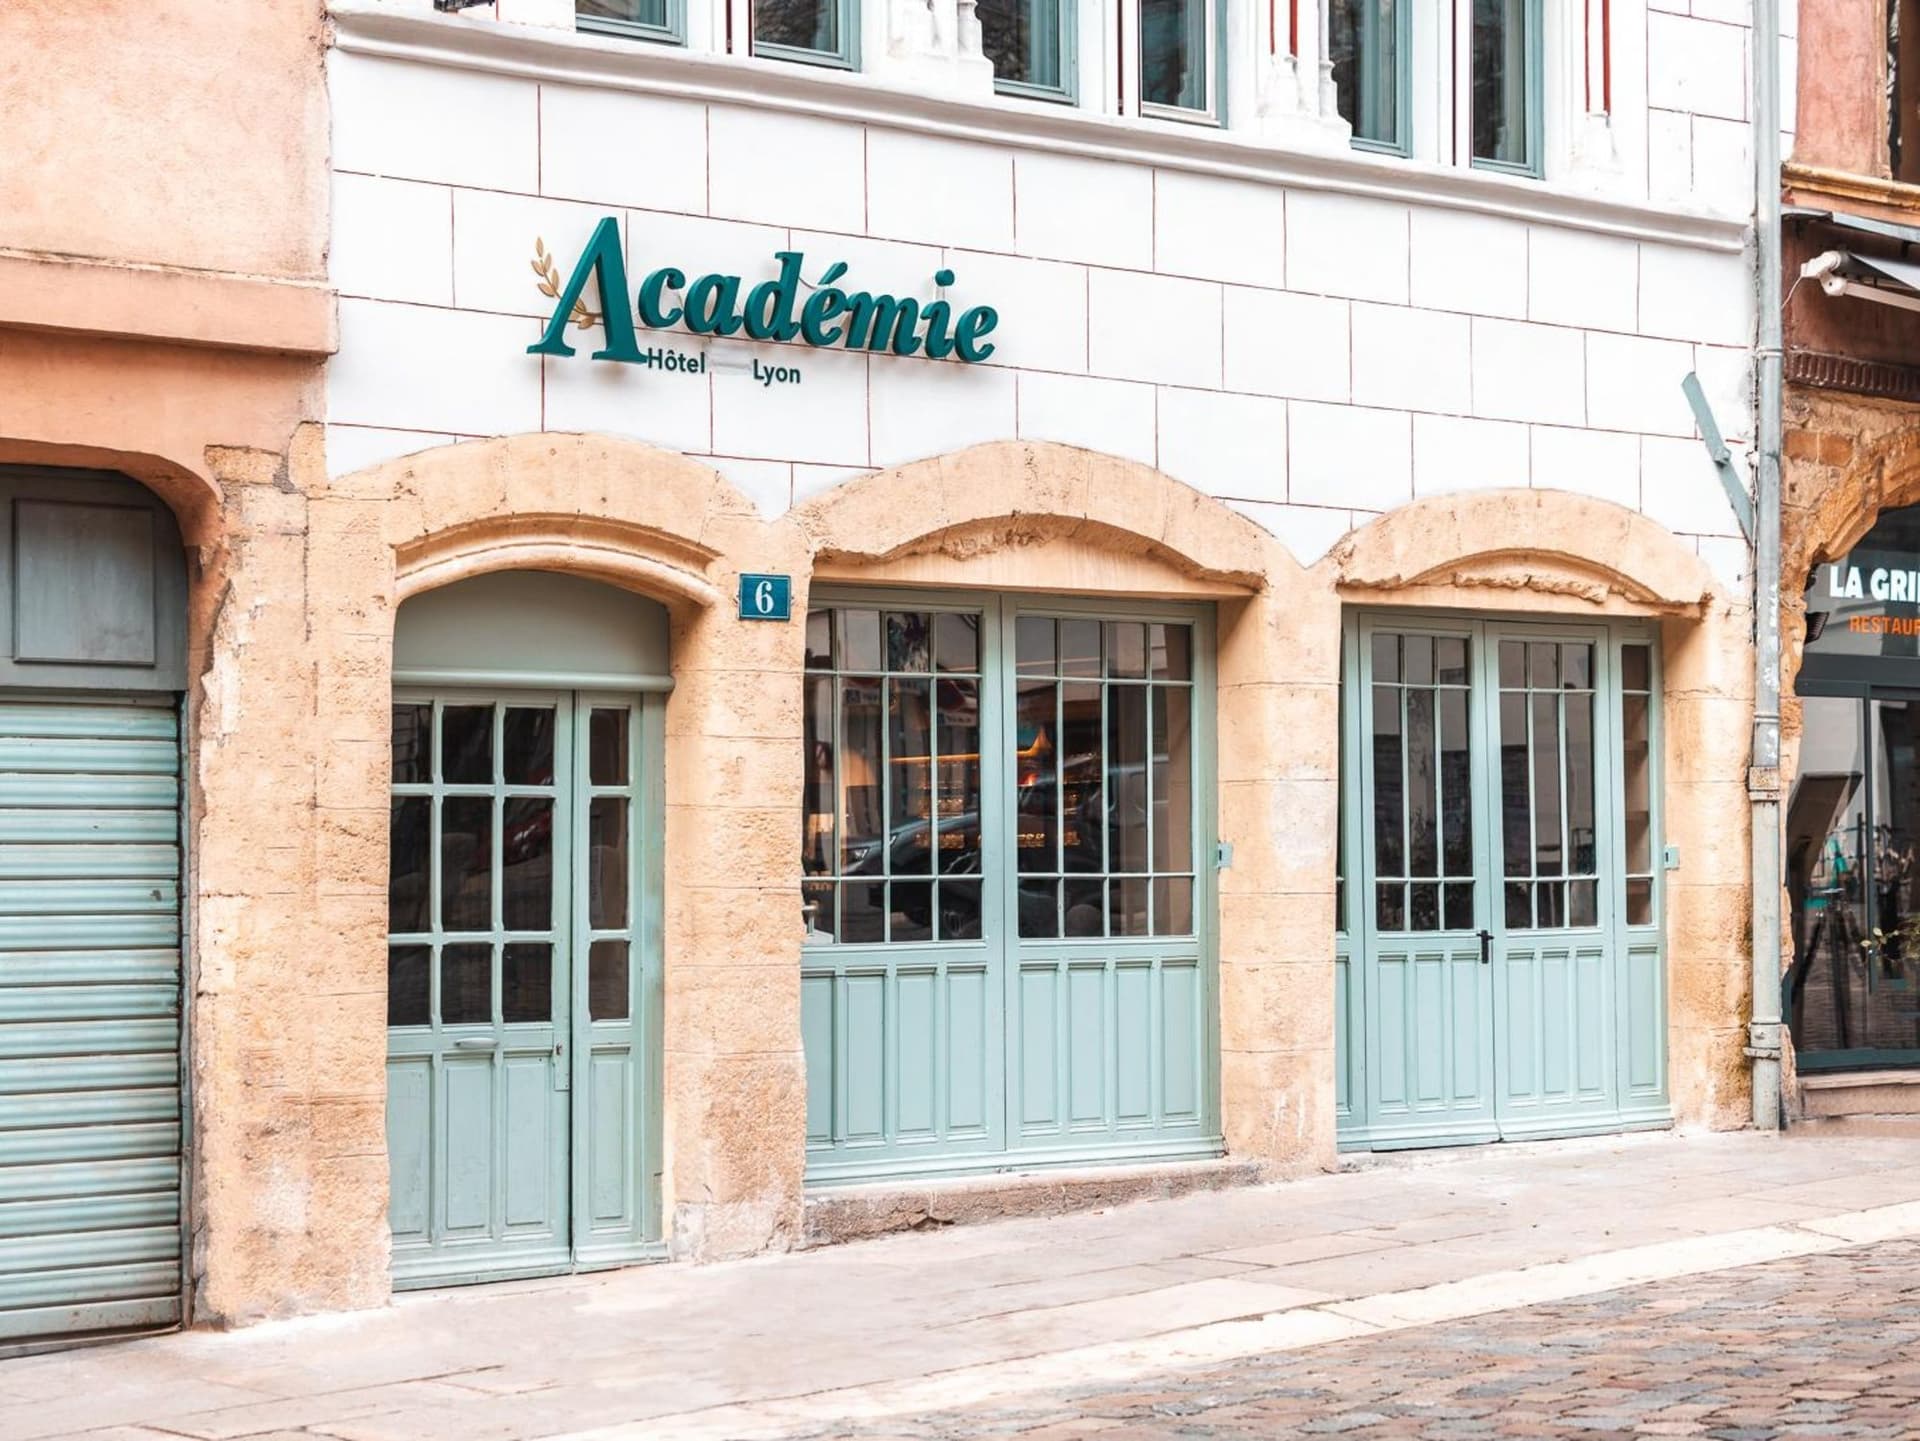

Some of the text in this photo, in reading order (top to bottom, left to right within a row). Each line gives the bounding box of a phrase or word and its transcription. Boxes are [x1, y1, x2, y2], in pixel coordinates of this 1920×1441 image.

[526, 216, 999, 362] Académie
[648, 347, 800, 386] Hôtel Lyon
[755, 580, 774, 614] 6
[1829, 565, 1920, 603] LA GRI
